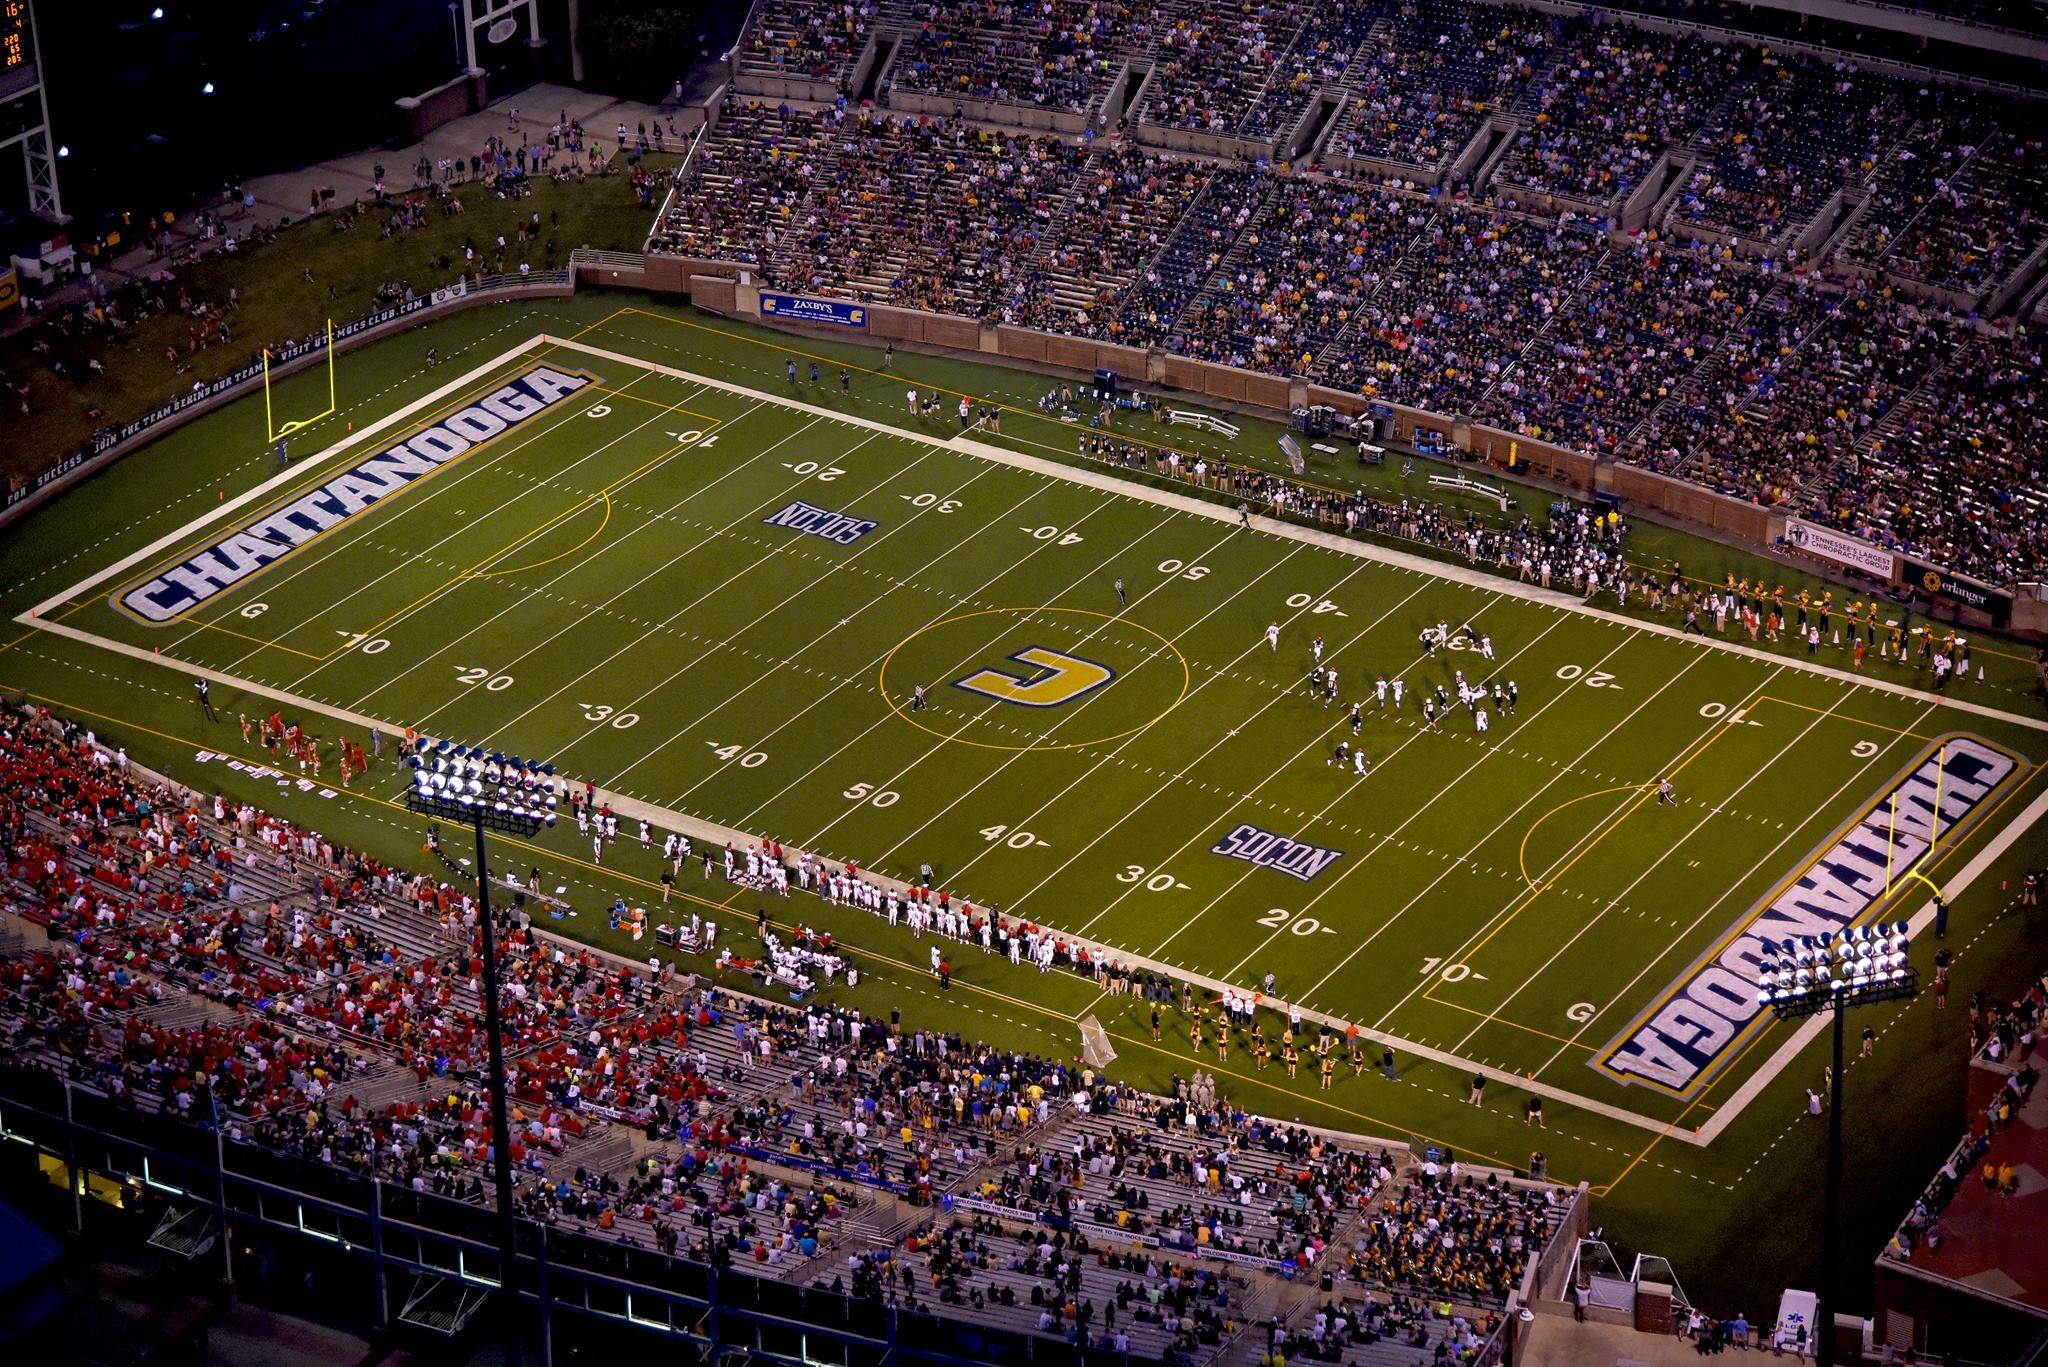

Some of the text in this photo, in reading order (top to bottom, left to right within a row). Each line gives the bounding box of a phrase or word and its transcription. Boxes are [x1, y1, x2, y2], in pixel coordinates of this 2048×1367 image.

[4, 33, 19, 46] 220
[10, 43, 20, 54] 65
[7, 53, 22, 66] 285
[794, 300, 833, 314] ZAXBY'S
[281, 343, 311, 361] VISIT
[94, 432, 117, 454] JOIN
[121, 423, 141, 439] THE
[143, 406, 172, 426] TEAM
[173, 388, 211, 412] BEHIND
[212, 375, 233, 392] OUR
[677, 430, 720, 448] 10
[7, 452, 83, 505] FOR SUCCESS
[793, 461, 847, 482] 20
[124, 367, 589, 623] CHATTANOOGA
[912, 493, 963, 514] 30
[762, 500, 878, 545] SOCON
[1032, 525, 1085, 546] 40
[1811, 533, 1858, 555] TENNESSEE'S
[1859, 550, 1891, 566] LARGEST
[1811, 541, 1891, 572] CHIROPRACTIC GROUP
[1157, 559, 1211, 582] 50
[1285, 593, 1340, 615] 40
[1942, 581, 1987, 604] erlanger
[239, 602, 269, 619] G
[345, 633, 391, 655] 10
[456, 667, 514, 692] 20
[1556, 664, 1617, 688] 20
[584, 704, 640, 729] 30
[1699, 702, 1748, 724] 10
[714, 744, 769, 768] 40
[843, 782, 900, 808] 50
[979, 824, 1036, 849] 40
[1211, 823, 1343, 882] SOCON
[1116, 864, 1176, 892] 30
[1256, 908, 1321, 936] 20
[1607, 738, 2015, 1088] CHATTANOOGA
[1419, 956, 1471, 982] 10
[1566, 1002, 1597, 1023] G
[955, 1197, 982, 1208] WELCOME
[1003, 1207, 1019, 1216] MOCS
[1020, 1211, 1033, 1219] NEST
[1077, 1223, 1103, 1233] WELCOME
[1125, 1233, 1142, 1241] MOCS
[1200, 1248, 1229, 1258] WELCOME
[1250, 1257, 1268, 1266] MOCS
